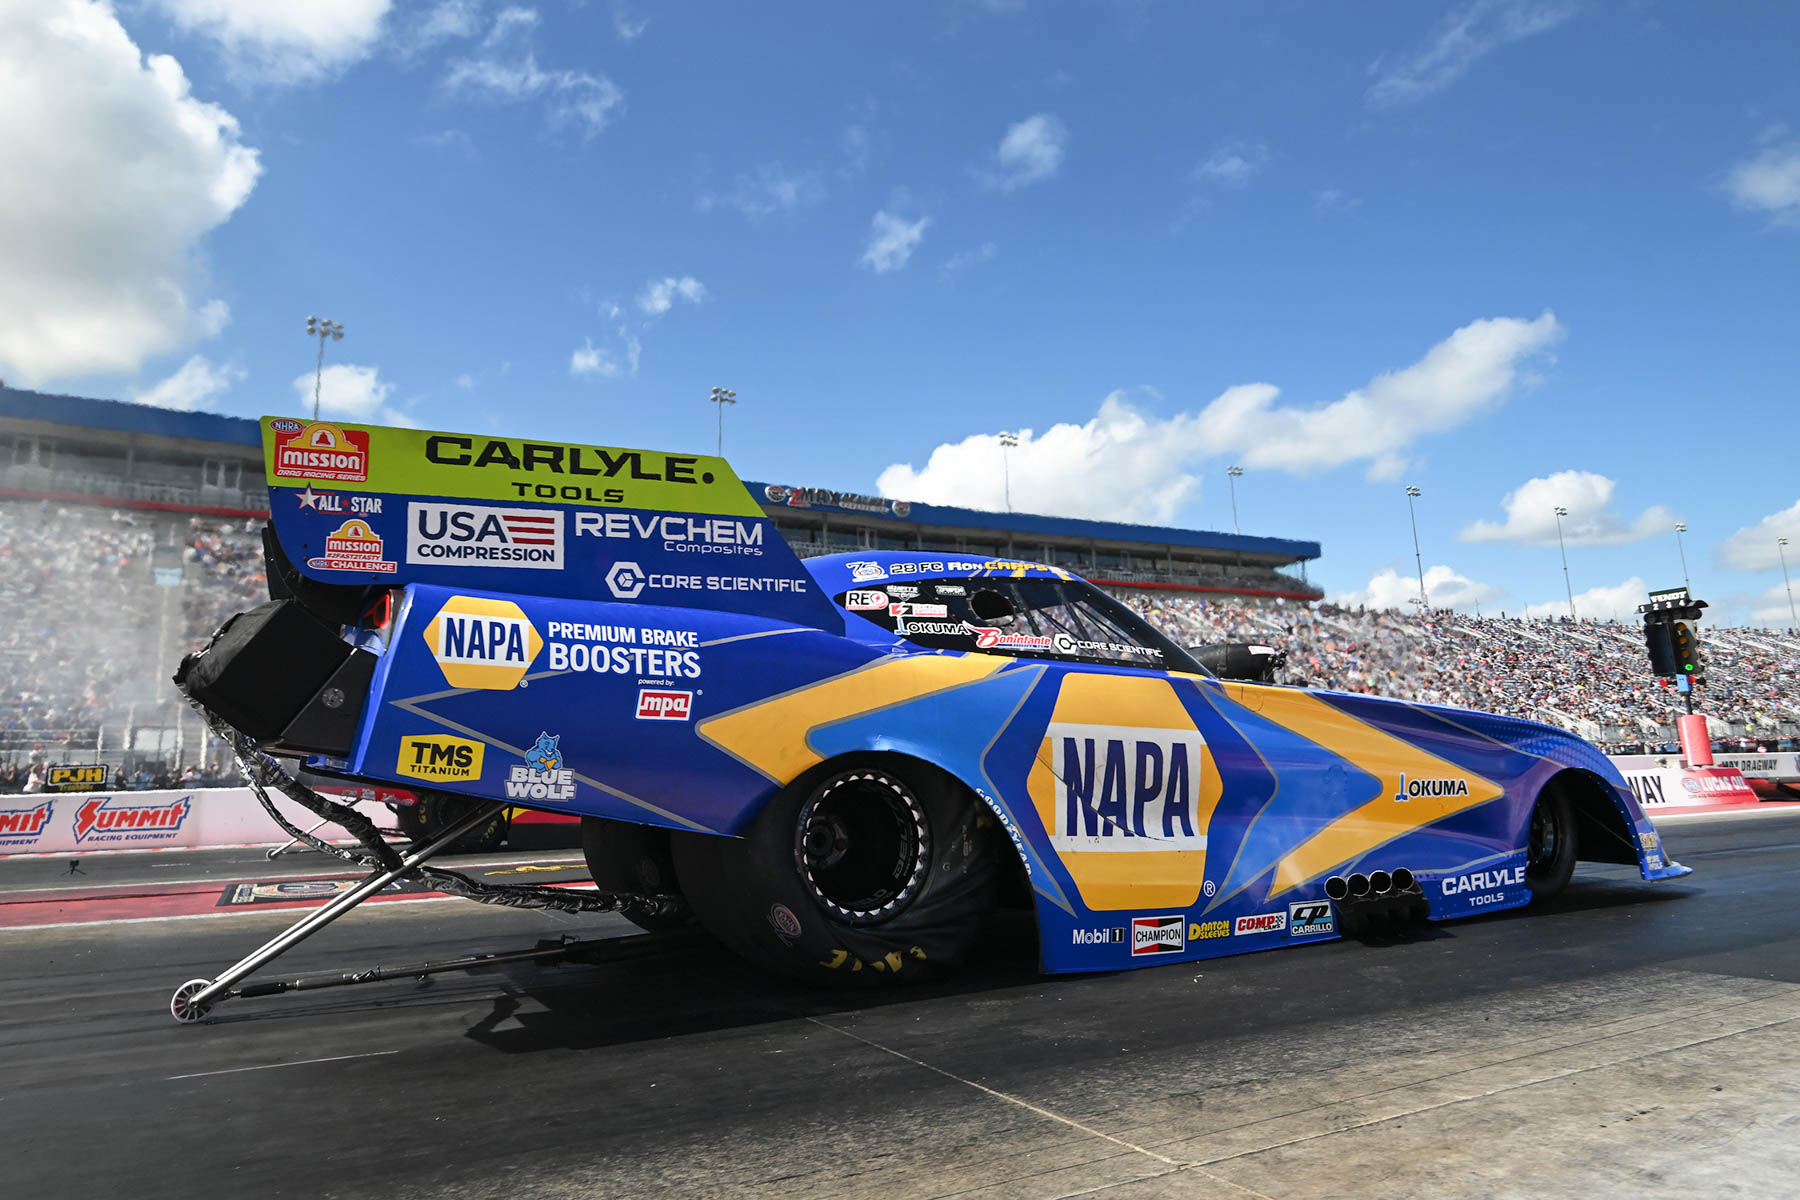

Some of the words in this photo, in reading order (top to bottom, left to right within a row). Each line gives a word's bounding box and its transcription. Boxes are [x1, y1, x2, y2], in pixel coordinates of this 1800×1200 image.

[274, 420, 300, 431] NHRA
[276, 469, 302, 477] DRAG
[303, 471, 337, 479] RACING
[512, 482, 625, 503] TOOLS
[318, 495, 343, 512] ALL
[350, 496, 383, 514] STAR
[418, 510, 509, 543] USA
[575, 512, 764, 546] REVCHEM
[417, 544, 556, 563] COMPRESSION
[663, 540, 764, 556] Composites
[331, 560, 394, 572] CHALLENGE
[890, 563, 916, 574] 28
[919, 562, 943, 573] FC
[648, 573, 703, 590] CORE
[706, 575, 807, 593] SCIENTIFIC
[548, 621, 636, 644] PREMIUM
[641, 628, 700, 648] BRAKE
[907, 621, 970, 635] OKUMA
[446, 617, 525, 662] NAPA
[1076, 640, 1109, 650] CORE
[549, 642, 702, 678] BOOSTERS
[637, 678, 664, 686] powered
[640, 696, 689, 717] mpa
[411, 742, 473, 768] TMS
[410, 764, 470, 776] TITANIUM
[1741, 759, 1778, 771] DRAGWAY
[52, 768, 103, 783] PJH
[511, 767, 573, 785] BLUE
[1699, 775, 1733, 791] LUCAS
[507, 782, 575, 799] WOLF
[1063, 737, 1195, 838] NAPA
[1408, 780, 1468, 797] OKUMA
[87, 834, 122, 842] RACING
[125, 832, 178, 841] EQUIPMENT
[1441, 866, 1526, 896] CARLYLE
[1469, 892, 1504, 906] TOOLS
[1237, 914, 1276, 932] COMP
[1291, 922, 1333, 934] CARRILLO
[1072, 928, 1110, 945] Mobil
[1135, 927, 1182, 943] CHAMPION
[1200, 930, 1231, 940] SLEEVES
